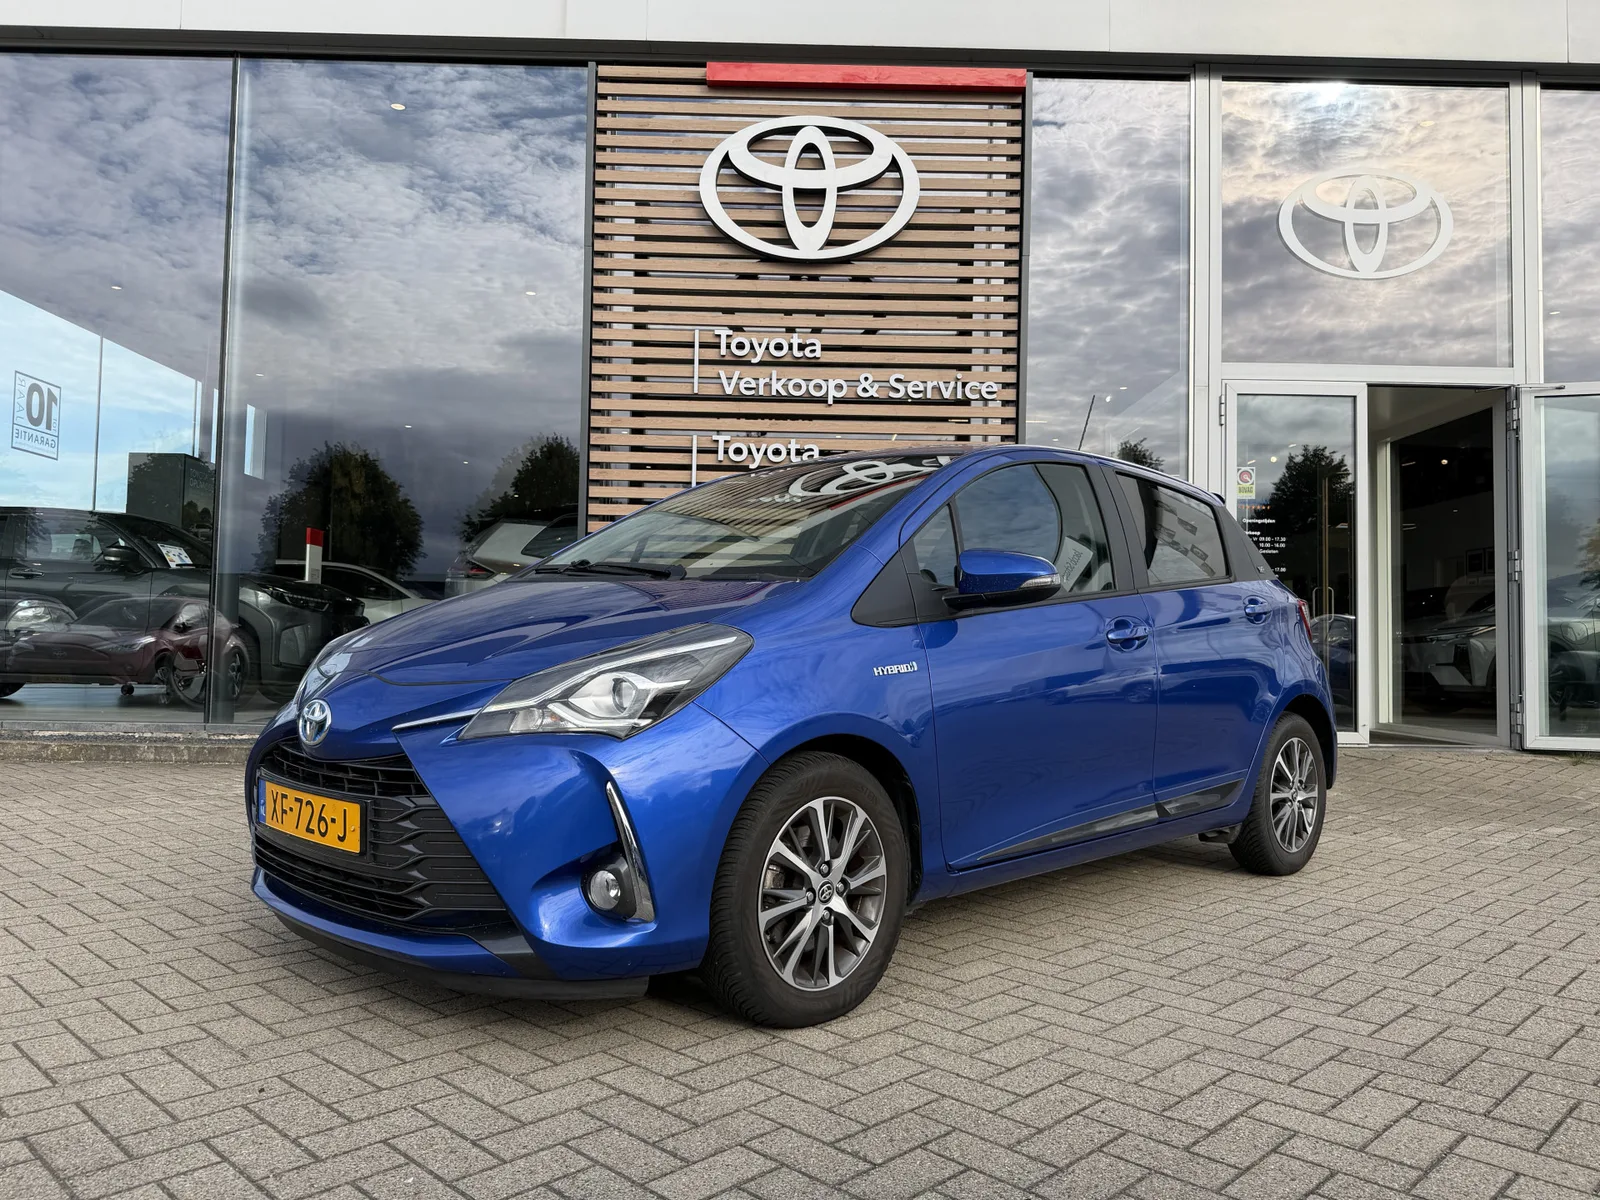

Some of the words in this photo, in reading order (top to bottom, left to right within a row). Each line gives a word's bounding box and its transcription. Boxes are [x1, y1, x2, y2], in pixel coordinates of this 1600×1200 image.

[714, 329, 821, 363] Toyota
[719, 370, 848, 405] Verkoop
[856, 373, 879, 398] &
[888, 373, 998, 399] Service
[712, 435, 820, 468] Toyota
[873, 663, 911, 676] HYBRID
[261, 806, 266, 816] NL
[271, 789, 347, 843] XF-726-J
